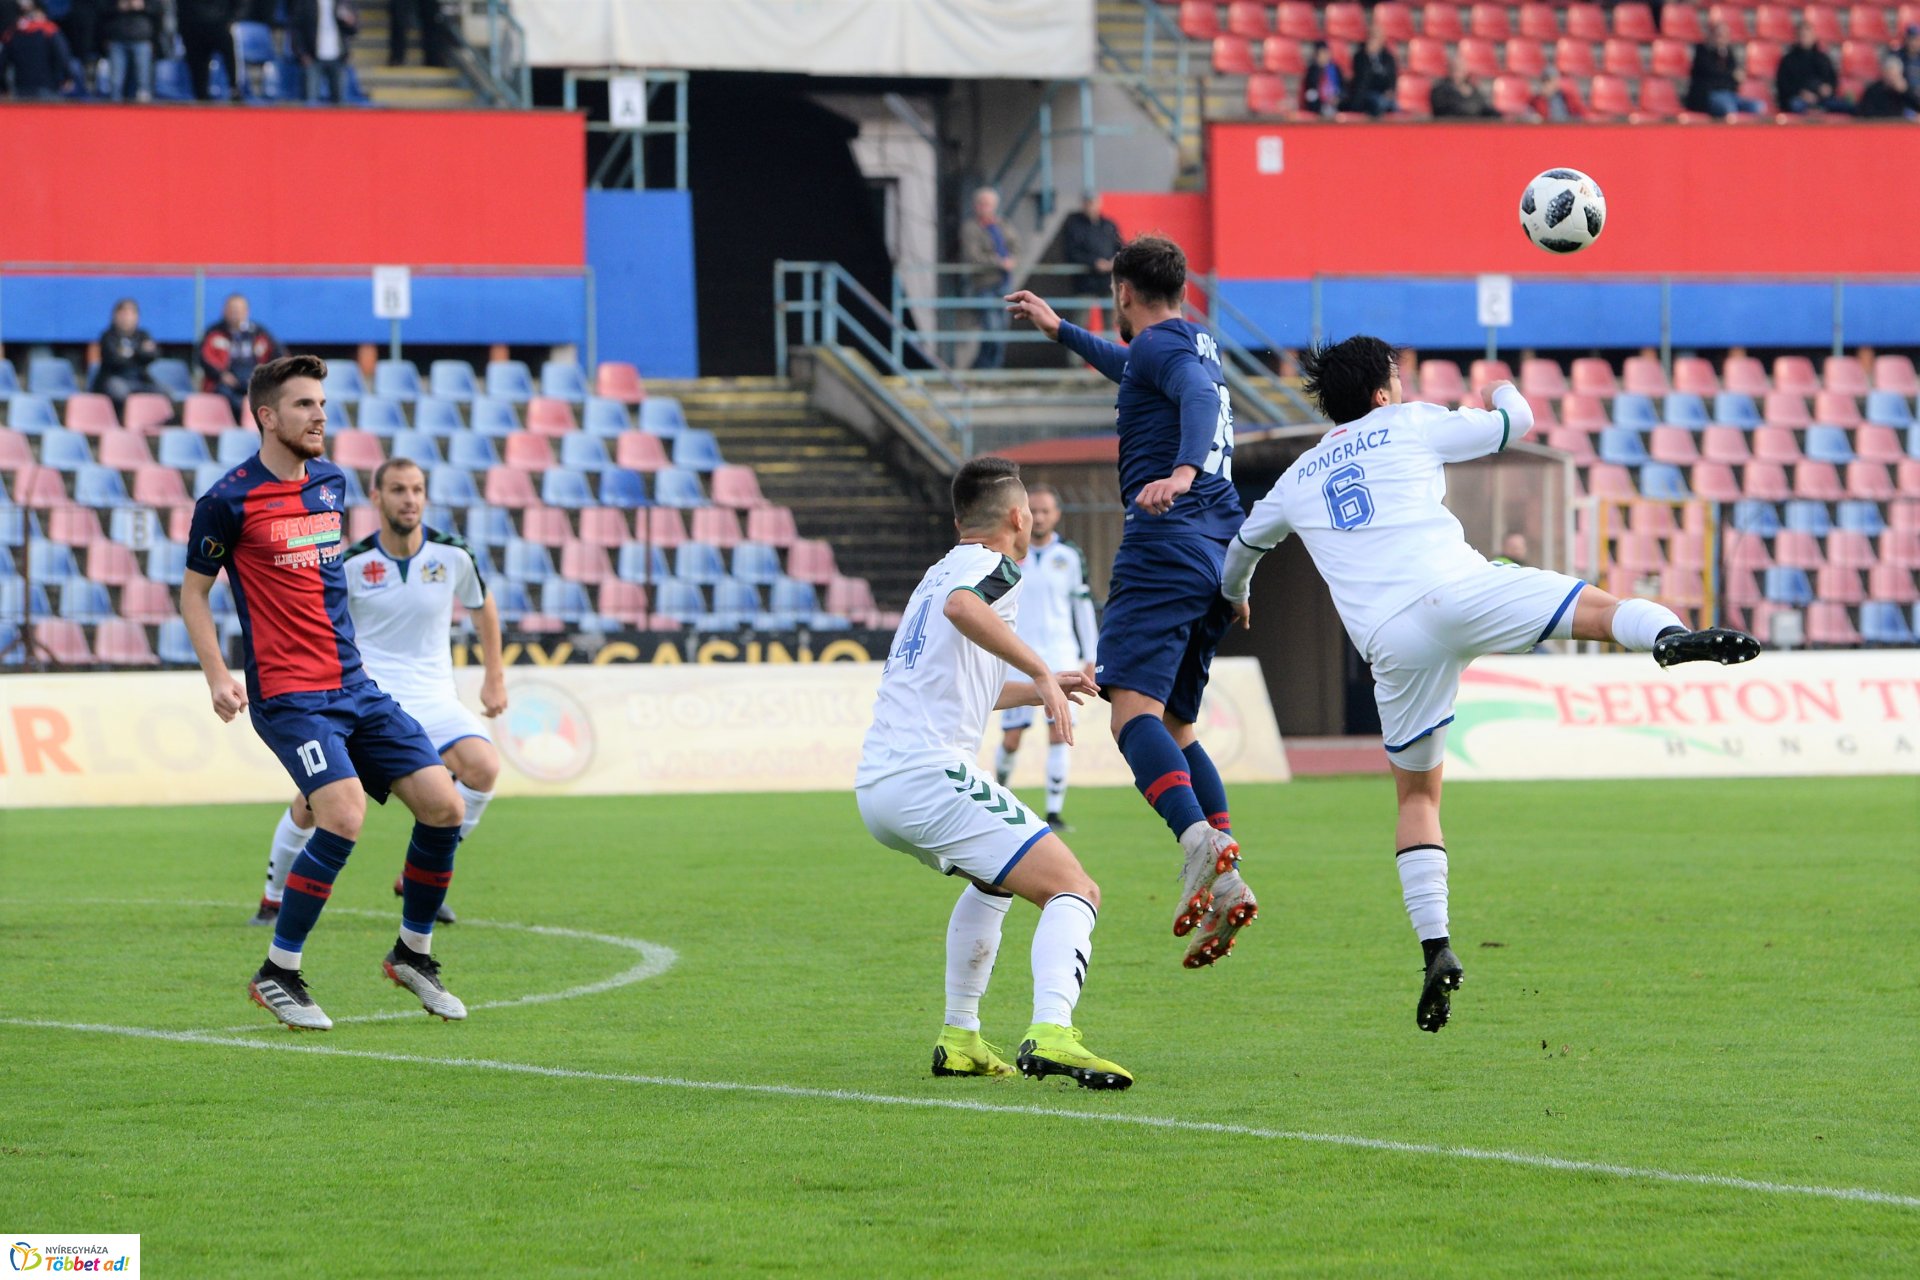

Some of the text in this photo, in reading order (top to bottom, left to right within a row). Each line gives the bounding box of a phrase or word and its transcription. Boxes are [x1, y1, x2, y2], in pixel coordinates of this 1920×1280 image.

[1297, 429, 1391, 484] PONGRÁCZ
[1322, 463, 1375, 531] 6
[1551, 680, 1844, 726] LERTON
[296, 739, 328, 777] 10
